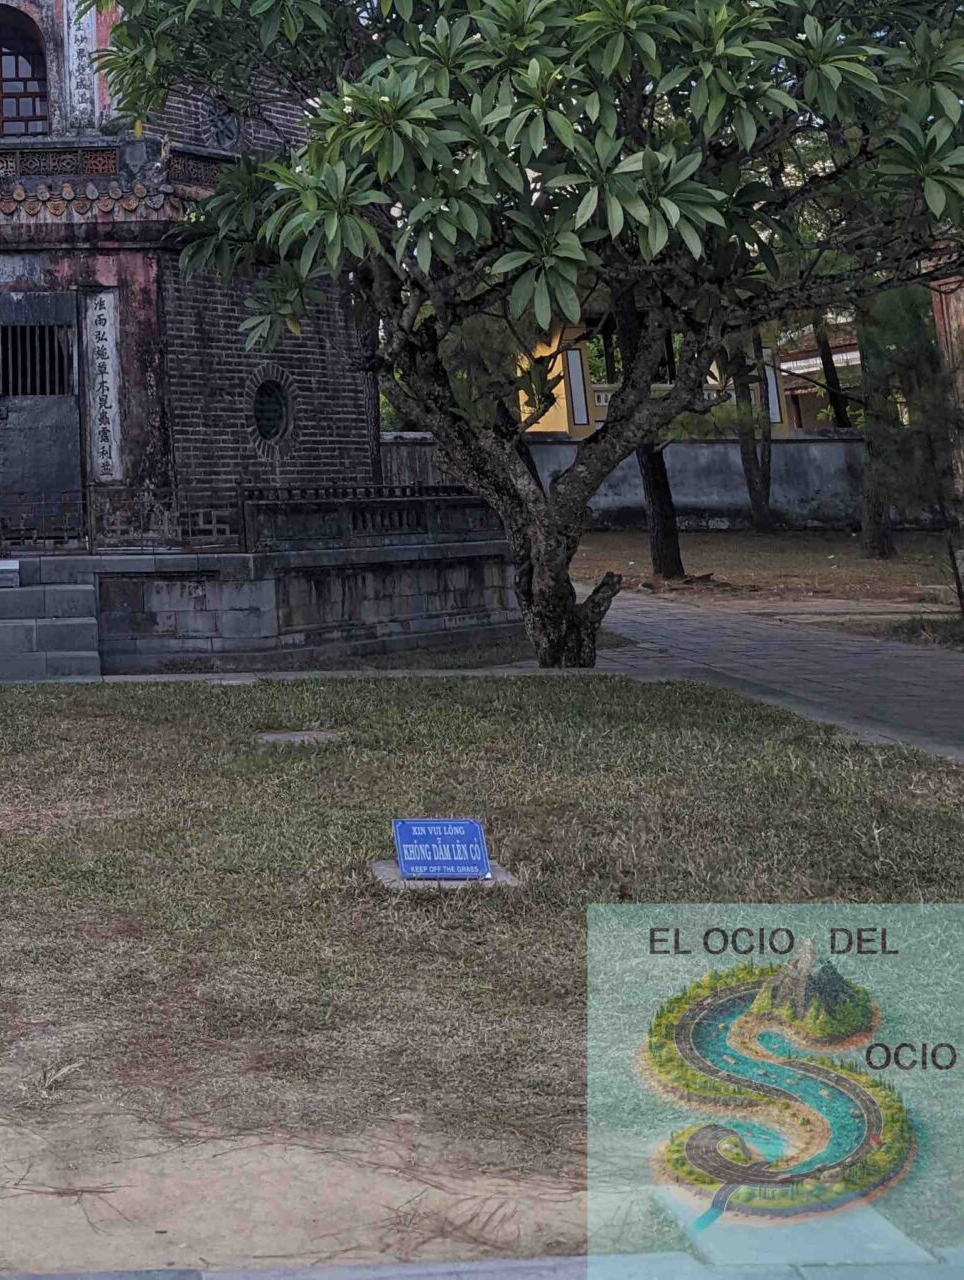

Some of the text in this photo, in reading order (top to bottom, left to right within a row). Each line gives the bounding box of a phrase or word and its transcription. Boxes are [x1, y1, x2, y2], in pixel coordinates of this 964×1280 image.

[412, 826, 426, 835] XIN
[428, 826, 442, 835] VUI
[402, 840, 432, 860] KHÔNG
